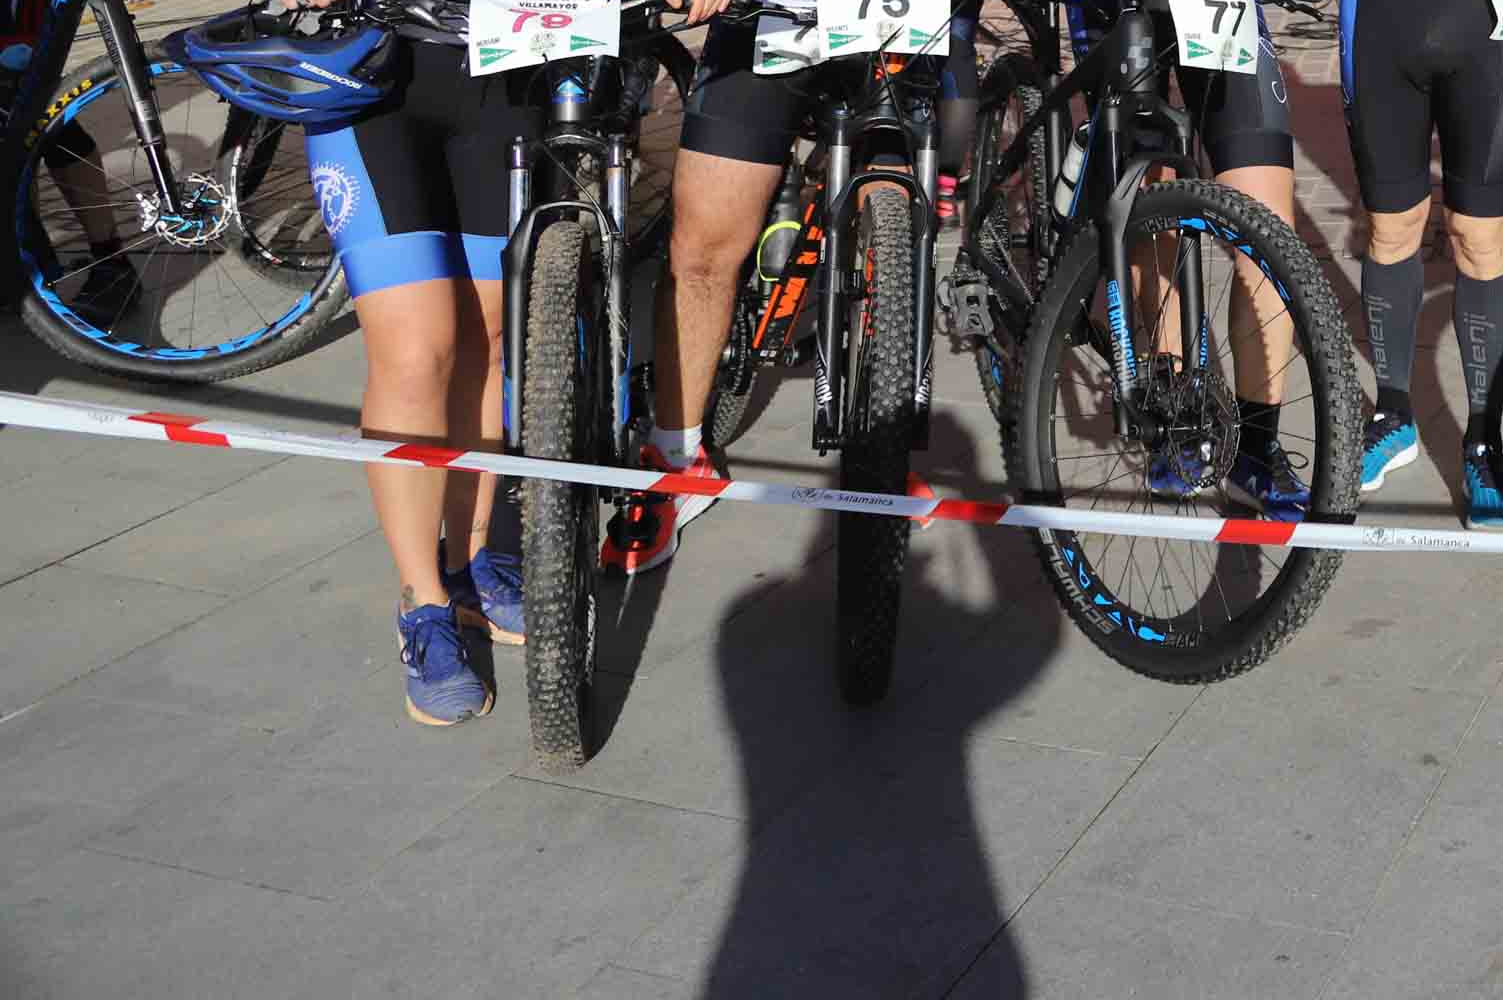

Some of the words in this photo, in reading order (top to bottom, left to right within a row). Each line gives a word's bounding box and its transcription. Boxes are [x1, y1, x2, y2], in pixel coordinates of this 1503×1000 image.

[519, 1, 578, 10] VILLAMAYOR
[1204, 0, 1247, 37] 77
[509, 7, 573, 33] 79
